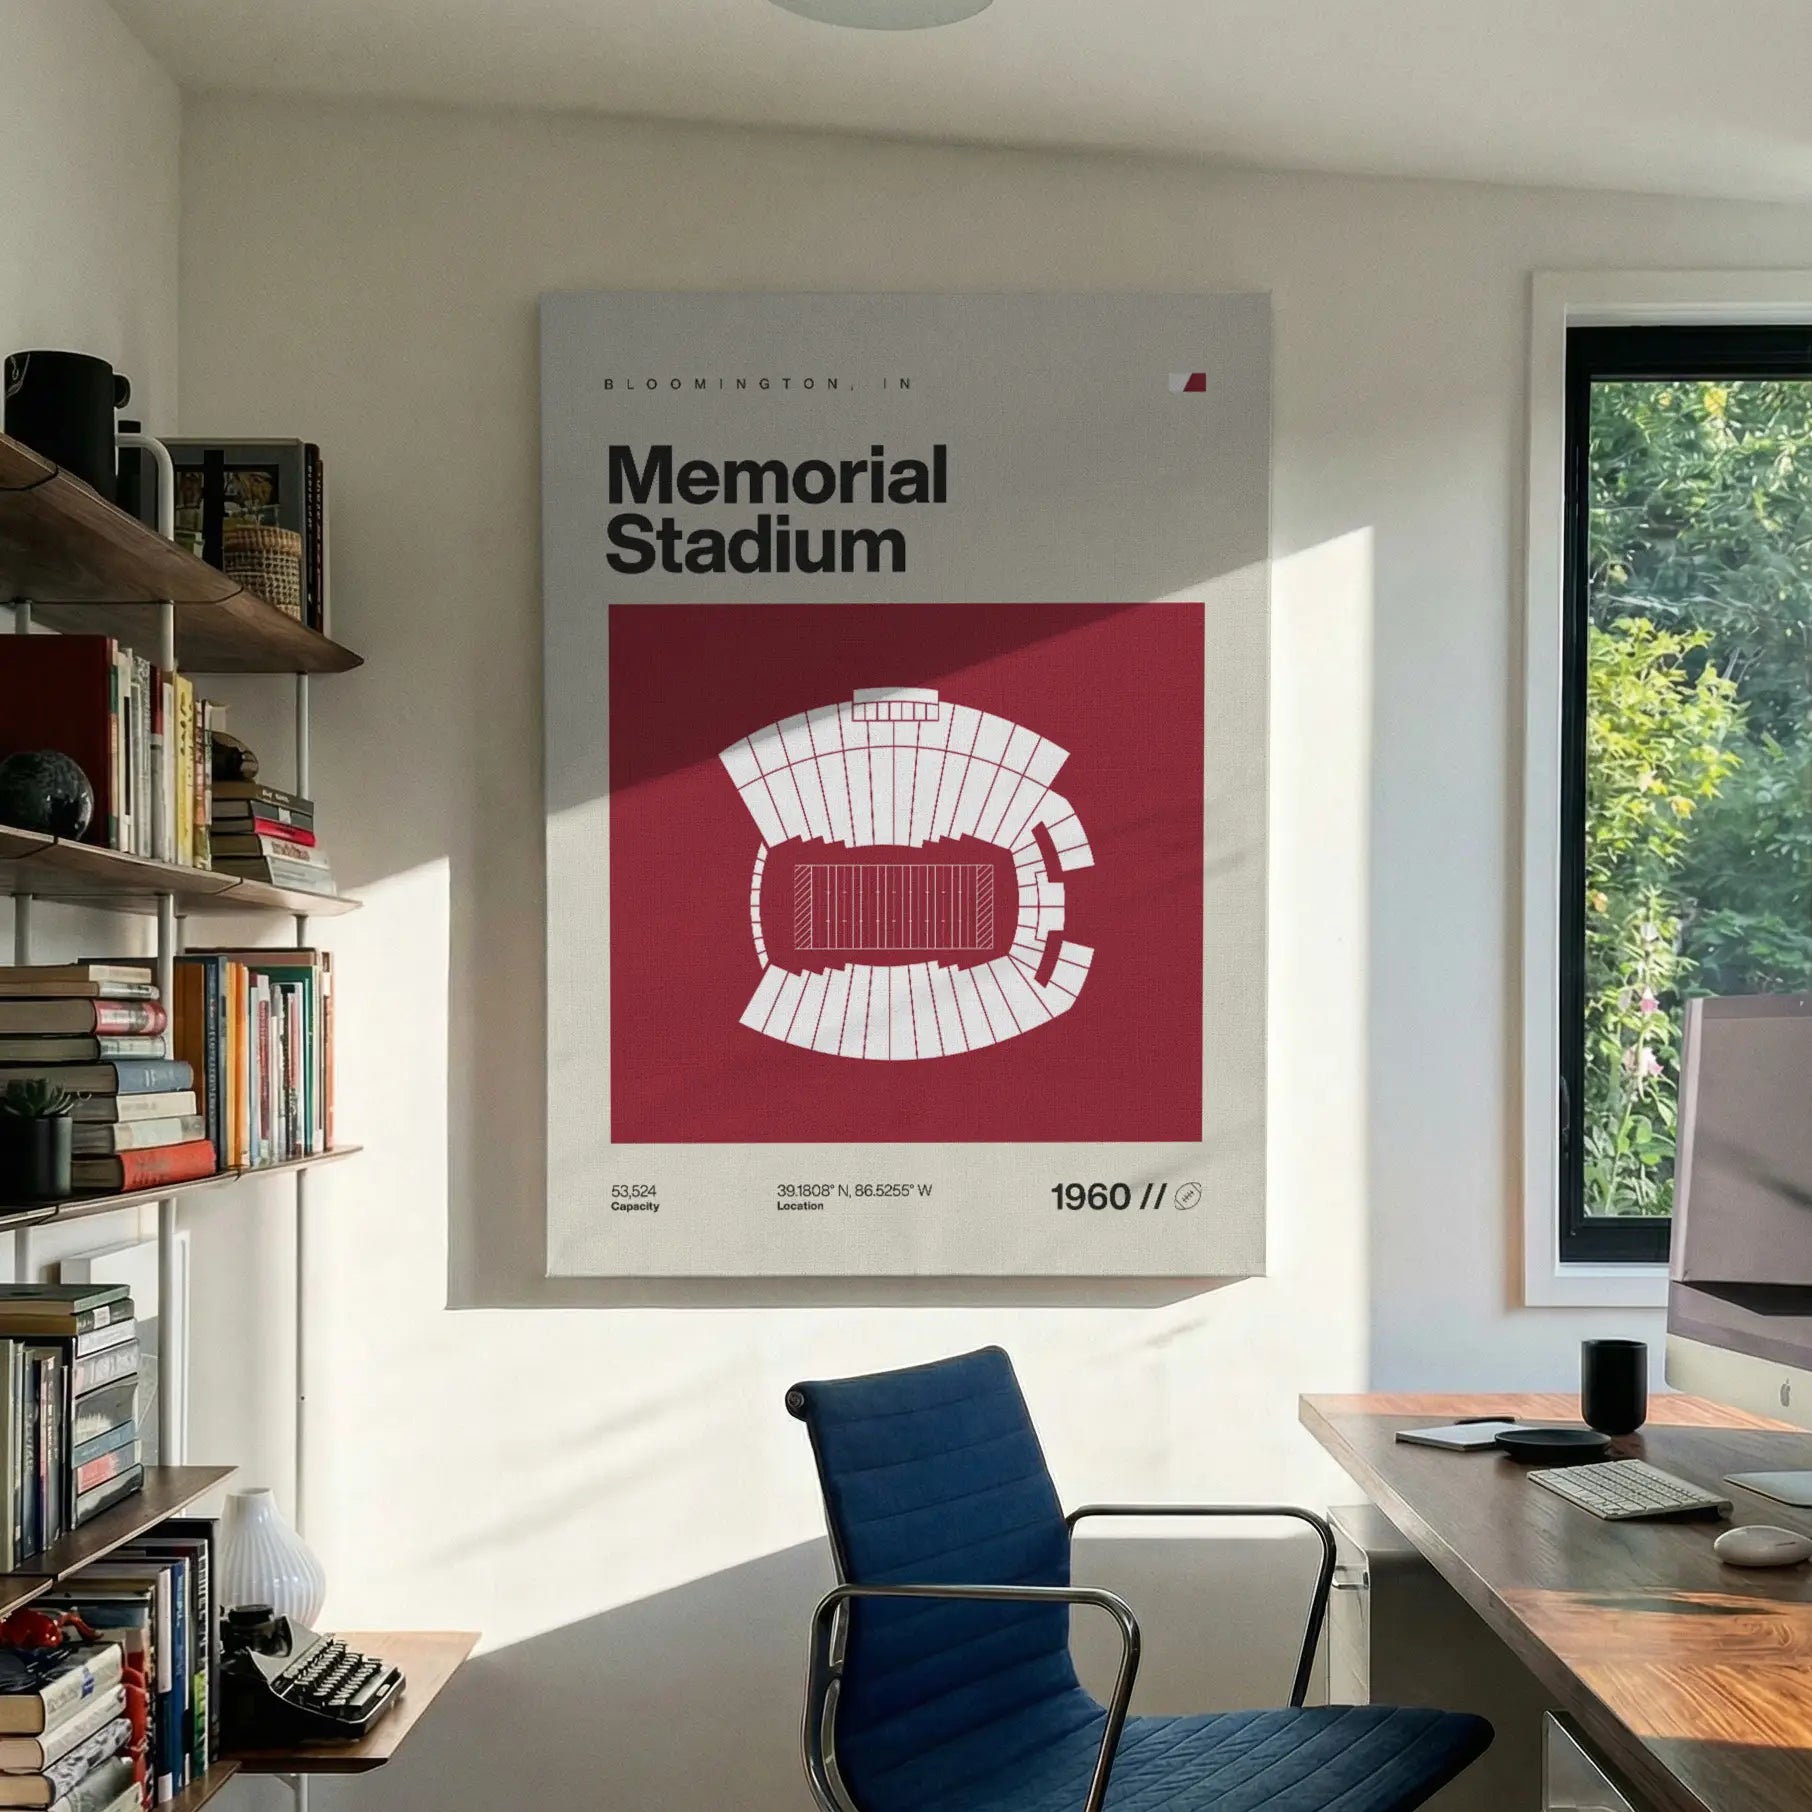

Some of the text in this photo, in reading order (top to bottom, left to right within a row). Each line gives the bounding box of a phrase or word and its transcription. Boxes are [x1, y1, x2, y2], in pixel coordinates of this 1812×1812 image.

[604, 377, 911, 393] BLOOMINGTON, IN
[607, 443, 948, 505] Memorial
[605, 513, 907, 575] Stadium
[611, 1184, 657, 1200] 53,524
[837, 1184, 852, 1200] N,
[854, 1183, 915, 1199] 86.5255°
[917, 1184, 933, 1198] W
[1050, 1182, 1132, 1211] 1960
[610, 1201, 660, 1214] Capacity
[777, 1201, 824, 1212] Location
